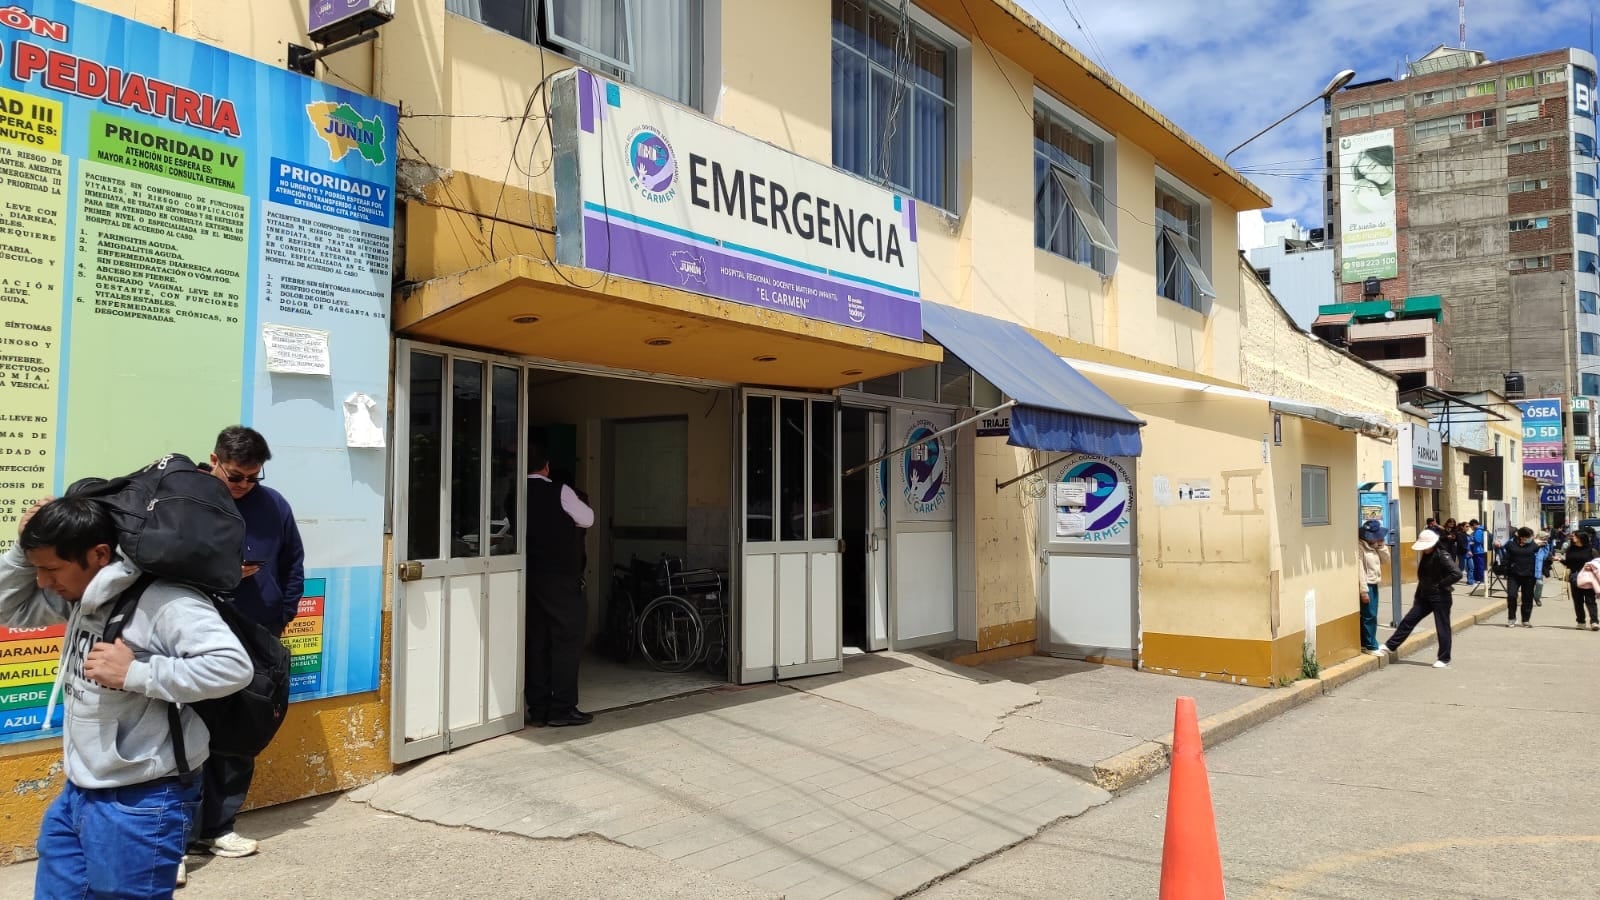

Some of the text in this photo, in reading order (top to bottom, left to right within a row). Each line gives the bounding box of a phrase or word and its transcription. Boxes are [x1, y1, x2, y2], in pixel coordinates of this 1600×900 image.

[14, 39, 242, 138] PEDIATRIA
[31, 104, 53, 123] III
[37, 124, 57, 136] ES:
[105, 123, 239, 168] PRIORIDAD IV
[17, 150, 62, 167] RIESGO DE
[125, 146, 212, 174] ATENCIÓN DE ESPERA ES:
[28, 164, 62, 176] AMERITA
[97, 149, 236, 190] MAYOR A 2 HORAS CONSULTA EXTERNA
[7, 179, 62, 195] PRIORIDAD LA
[280, 164, 387, 201] PRIORIDAD V
[290, 181, 318, 194] URGENTE
[85, 172, 245, 212] PACIENTES SIN COMPROMISO DE FUNCIONES
[641, 187, 676, 204] CARMEN
[6, 202, 57, 217] LEVE CON
[138, 199, 164, 211] TRATAN
[165, 204, 198, 218] SÍNTOMAS
[276, 187, 384, 217] ATENCIÓN TRANSFERIDO CONSULTA
[294, 198, 348, 217] EXTERNA CON CITA
[689, 152, 904, 268] EMERGENCIA
[84, 197, 233, 233] PARA SER ATENDIDO CONSULTA EXTERNA
[84, 206, 244, 243] PRIMER NIVEL ESPECIALIZADA MISMO
[85, 214, 195, 241] HOSPITAL DE ACUERDO AL CASO.
[97, 240, 185, 261] AMIGDALITIS AGUDA.
[98, 231, 179, 252] FARINGITIS AGUDA.
[96, 256, 111, 265] SIN
[113, 259, 186, 277] DESHIDRATACIÓN
[195, 271, 231, 284] VÓMITOS.
[97, 248, 240, 278] ENFERMEDADES DIARREICA AGUDA
[1382, 257, 1395, 265] 100
[96, 265, 178, 284] ABCESO EN FIEBRE.
[281, 276, 305, 285] FIEBRE
[4, 287, 31, 297] LEVE.
[96, 274, 143, 286] SANGRADO
[148, 281, 184, 292] VAGINAL
[189, 287, 209, 296] LEVE
[228, 293, 239, 301] NO
[311, 288, 334, 297] COMÚN
[720, 266, 838, 302] HOSPITAL REGIONAL DOCENTE MATERNO INFANTIL
[95, 290, 177, 308] VITALES ESTABLES.
[160, 291, 239, 308] CON FUNCIONES
[280, 291, 304, 300] DOLOR
[95, 299, 171, 315] ENFERMEDADES
[227, 316, 239, 324] NO
[95, 307, 176, 323] DESCOMPENSADAS.
[280, 298, 308, 308] DOLOR
[313, 302, 323, 310] DE
[328, 305, 370, 317] GARGANTA
[5, 320, 52, 332] SÍNTOMAS
[11, 381, 50, 390] VESICAL
[9, 414, 33, 422] LEVE
[1527, 405, 1558, 418] ÓSEA
[982, 418, 1009, 428] TRIAJE
[1541, 427, 1558, 437] 5D
[32, 432, 47, 440] DE
[1523, 468, 1558, 478] IGITAL
[914, 488, 946, 514] CARMEN
[1082, 516, 1129, 541] ARMEN
[0, 690, 48, 704] VERDE
[4, 714, 41, 729] AZUL
